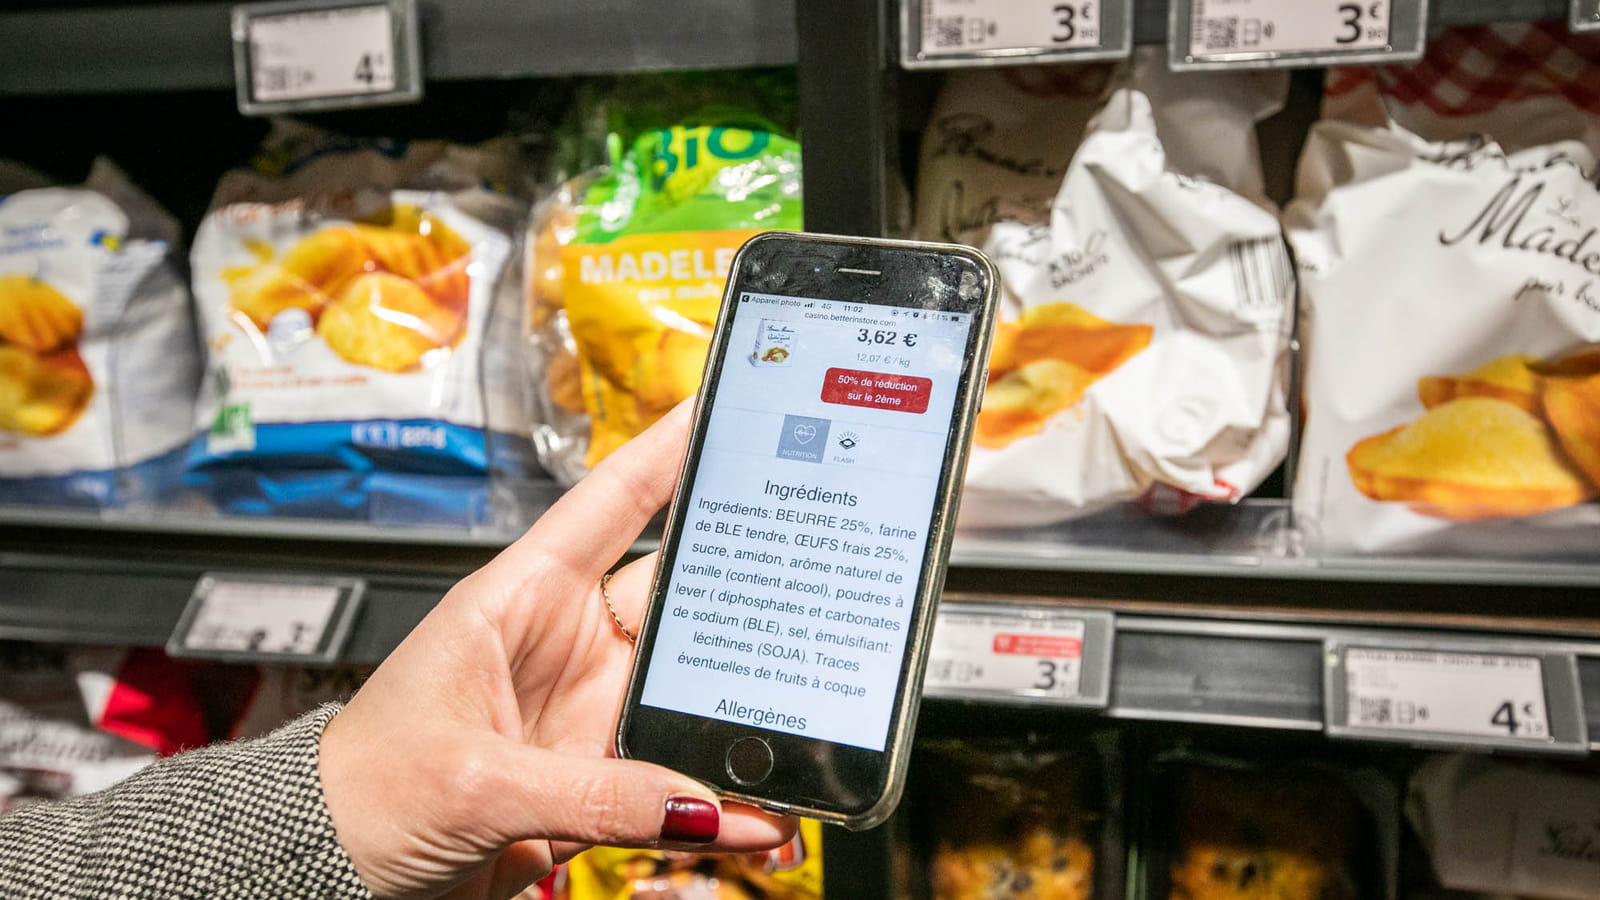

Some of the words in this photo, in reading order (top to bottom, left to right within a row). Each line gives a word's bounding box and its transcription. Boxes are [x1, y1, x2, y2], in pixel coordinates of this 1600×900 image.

[1052, 4, 1075, 43] 3
[1335, 3, 1363, 44] 3
[751, 296, 780, 305] Appareil
[780, 299, 801, 307] photo
[843, 305, 864, 313] 11:02
[805, 312, 897, 327] casino.betterinstore.com
[857, 328, 897, 346] 3,62
[903, 333, 918, 347] €
[856, 353, 881, 363] 12,07
[884, 356, 892, 364] €
[899, 357, 911, 368] kg
[838, 374, 859, 386] 50%
[861, 378, 873, 388] de
[847, 391, 863, 401] sur
[864, 393, 873, 402] le
[875, 394, 902, 406] 2ème
[782, 449, 818, 460] NUTRITION
[833, 455, 855, 465] FLASH
[764, 479, 858, 507] Ingrédients
[698, 497, 773, 519] Ingrédients:
[775, 508, 838, 529] BEURRE
[840, 518, 874, 536] 25%,
[879, 523, 917, 540] farine
[695, 519, 712, 532] de
[715, 521, 743, 536] BLE
[746, 527, 790, 545] tendre,
[794, 533, 840, 552] ŒUFS
[842, 540, 871, 557] frais
[874, 545, 909, 564] 25%,
[691, 543, 730, 558] sucre,
[734, 549, 785, 567] amidon,
[789, 557, 832, 573] arôme
[835, 564, 882, 581] naturel
[885, 571, 903, 584] de
[682, 563, 722, 579] vanille
[725, 568, 781, 589] (contient
[784, 578, 832, 599] alcool),
[836, 588, 892, 606] poudres
[895, 594, 904, 609] à
[674, 582, 707, 599] lever
[717, 590, 806, 616] diphosphates
[808, 605, 822, 618] et
[825, 610, 902, 632] carbonates
[672, 605, 689, 618] de
[692, 610, 739, 628] sodium
[742, 616, 783, 638] (BLE),
[787, 626, 810, 641] sel,
[815, 628, 894, 654] émulsifiant:
[692, 631, 753, 653] lécithines
[757, 642, 809, 665] (SOJA).
[815, 651, 860, 672] Traces
[677, 651, 751, 676] éventuelles
[754, 666, 771, 680] de
[775, 668, 809, 688] fruits
[811, 675, 820, 689] à
[823, 680, 867, 697] coque
[1034, 660, 1058, 690] 3
[714, 698, 808, 731] Allergènes
[1491, 701, 1519, 735] 4
